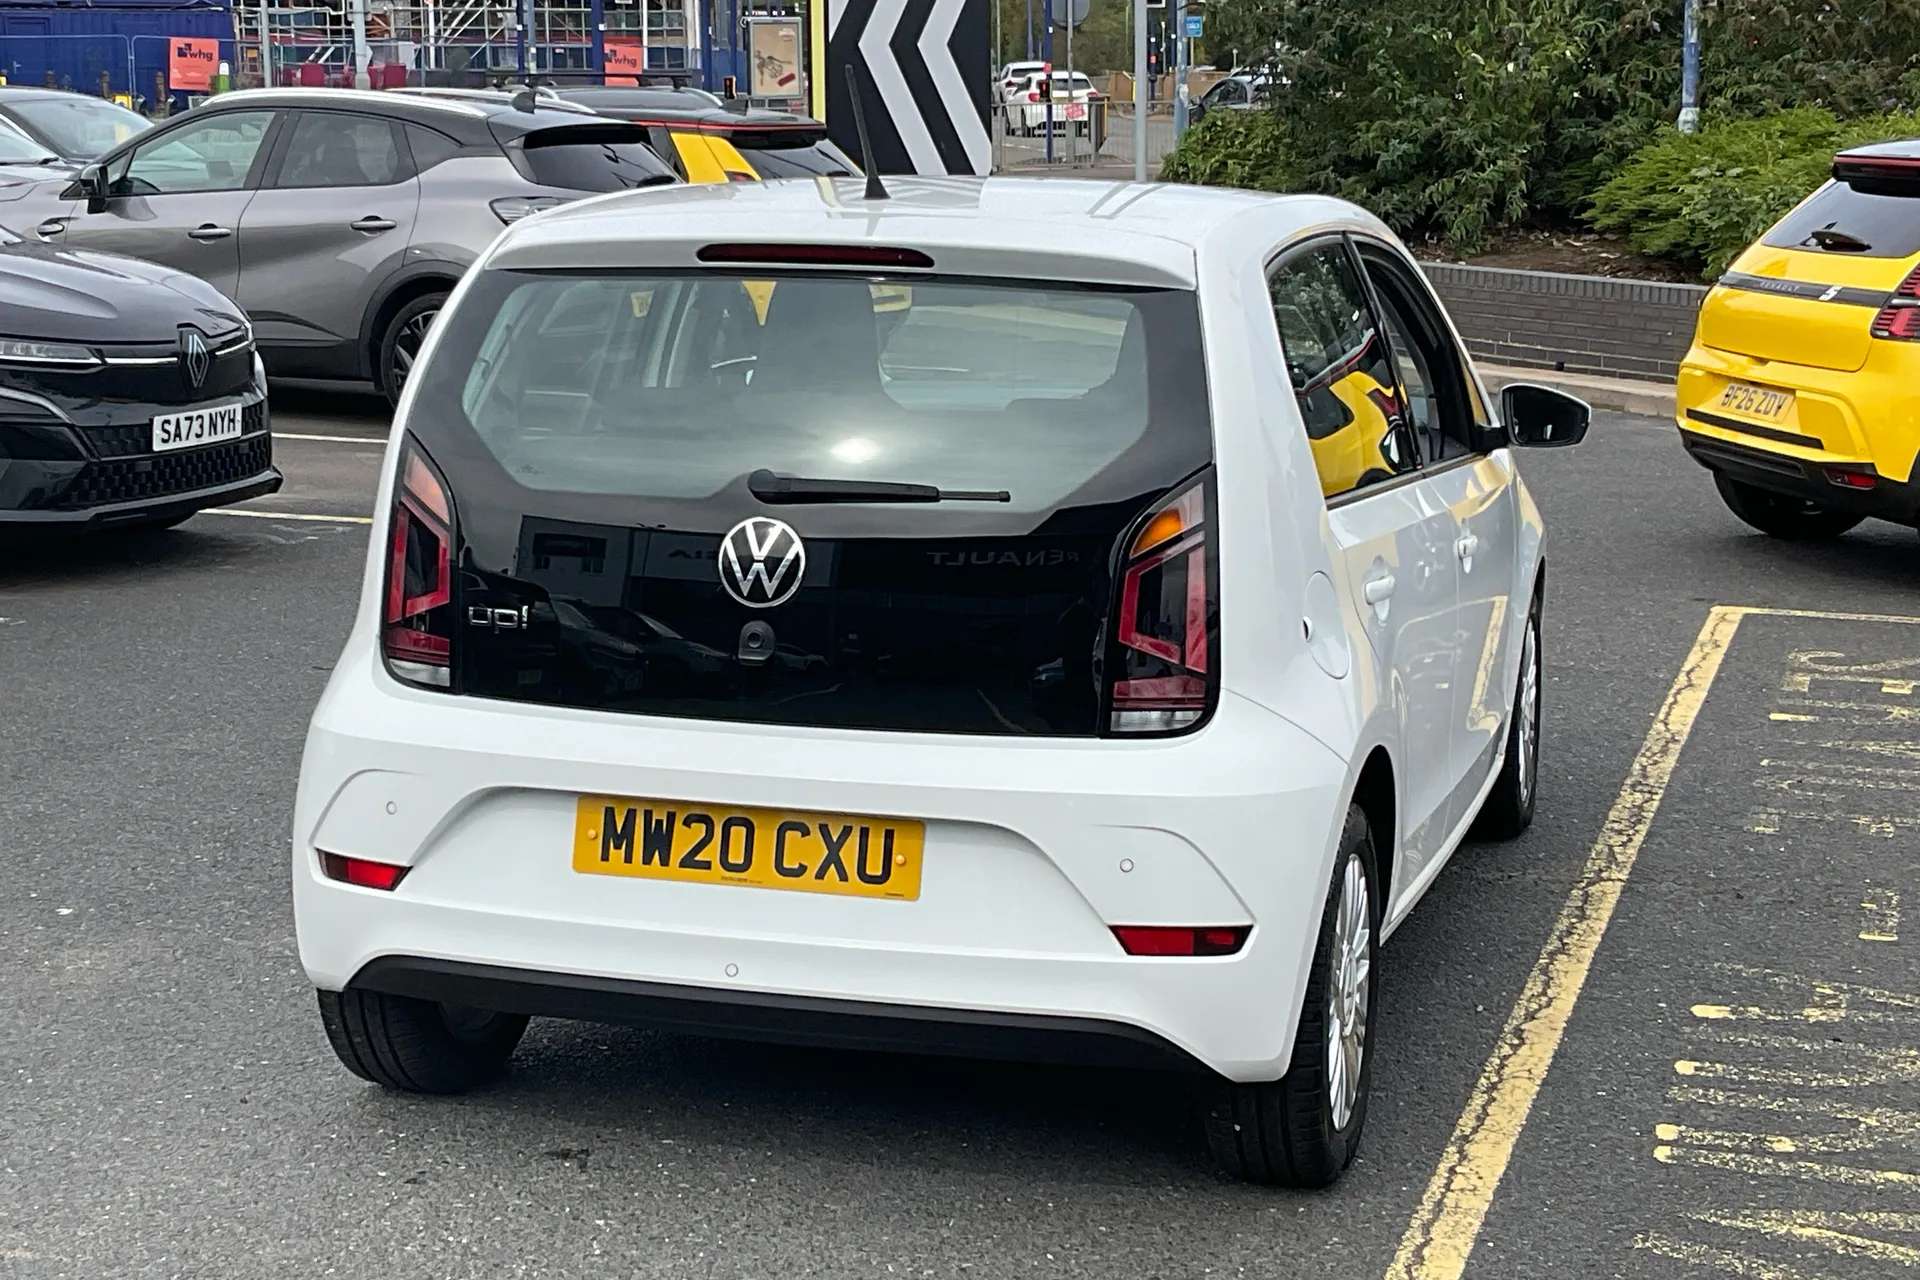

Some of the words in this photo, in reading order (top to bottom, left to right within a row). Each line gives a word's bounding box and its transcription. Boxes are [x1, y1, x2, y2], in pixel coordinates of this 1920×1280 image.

[189, 48, 214, 62] whg
[614, 55, 637, 68] whg
[1721, 384, 1757, 410] BF26
[161, 414, 205, 444] SA73
[208, 408, 237, 437] NYH
[600, 806, 755, 873] MW20
[773, 821, 895, 886] CXU
